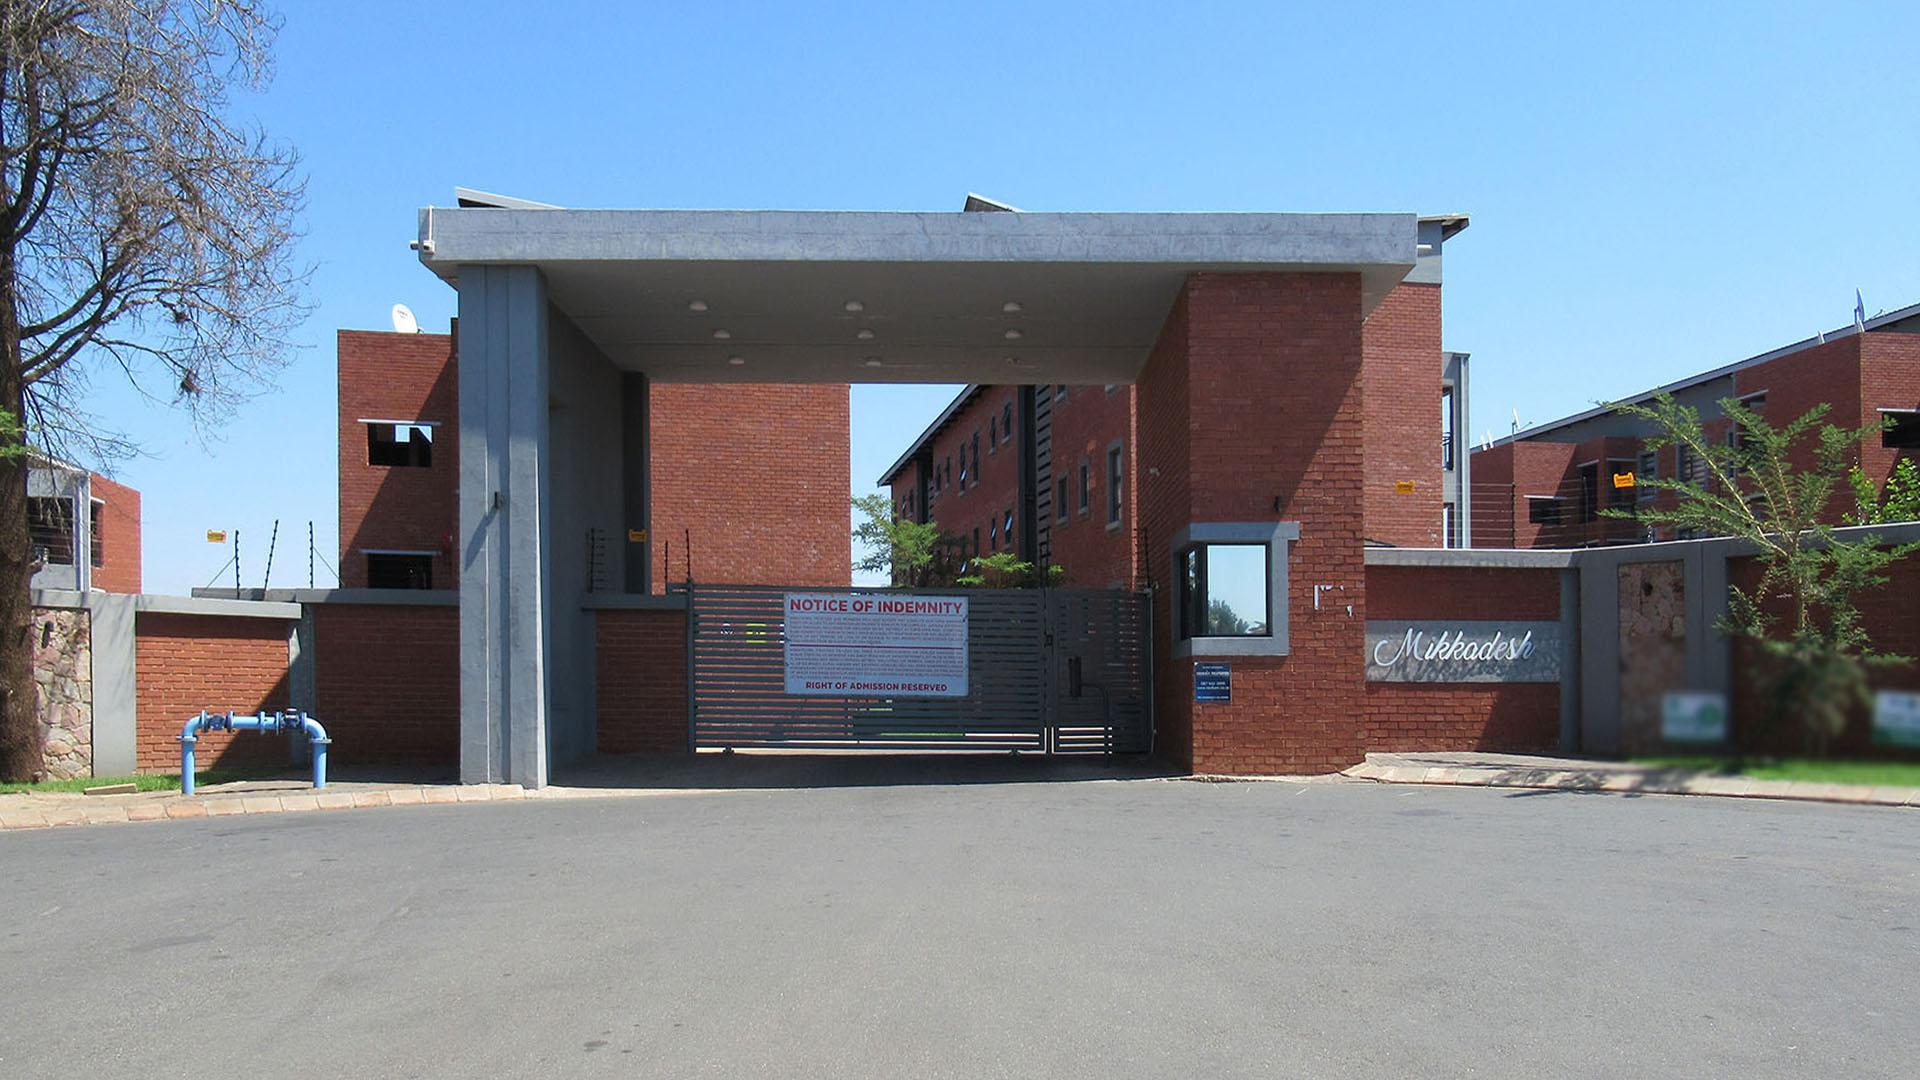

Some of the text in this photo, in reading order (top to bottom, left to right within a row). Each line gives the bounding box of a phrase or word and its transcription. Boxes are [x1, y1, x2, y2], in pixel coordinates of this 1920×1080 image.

[790, 599, 963, 614] NOTICE OF INDEMNITY
[1374, 628, 1536, 667] Mikkadesh
[805, 681, 948, 692] RIGHT OF ADMISSION RESERVED
